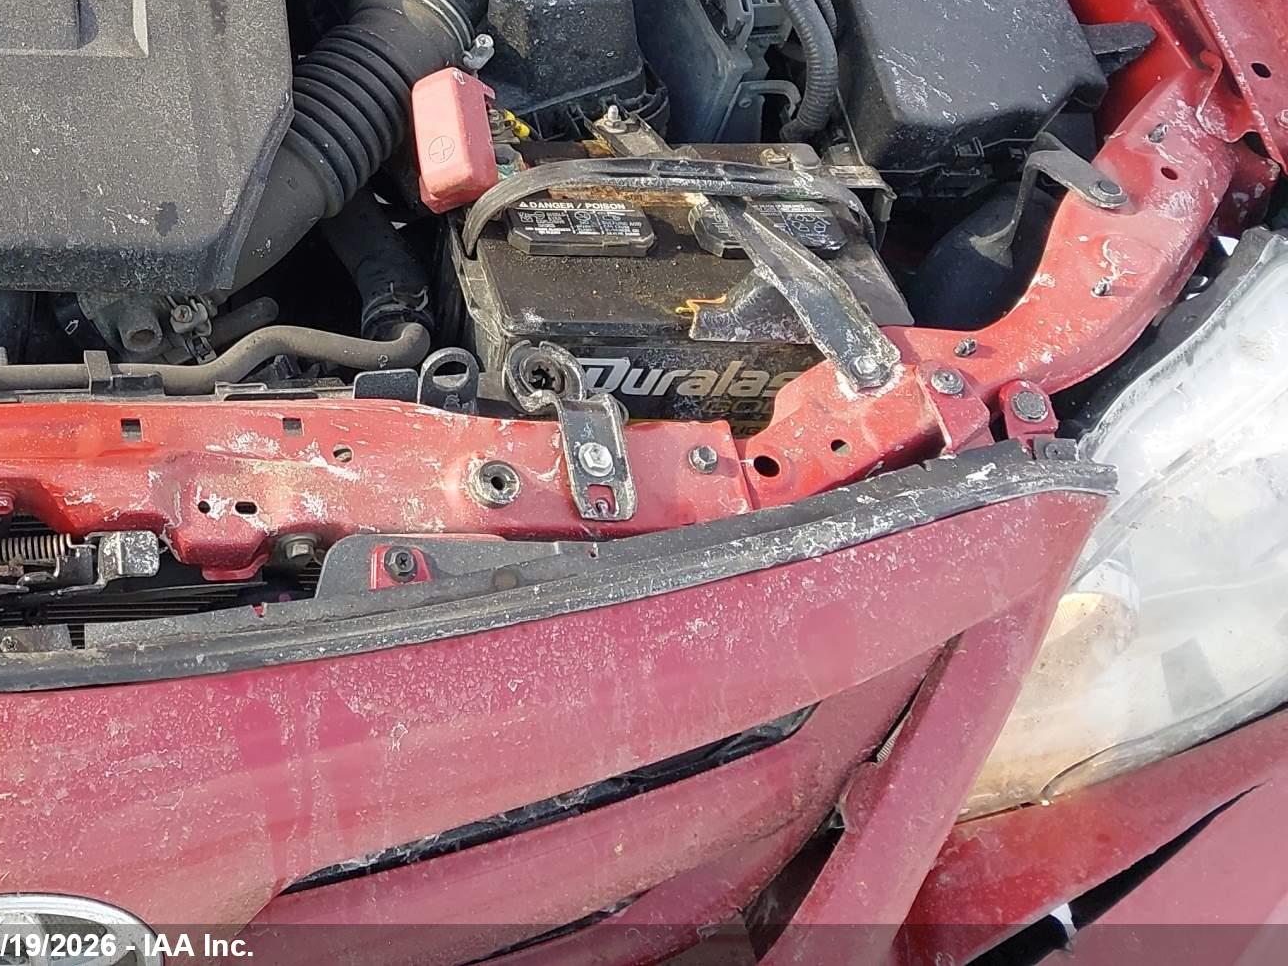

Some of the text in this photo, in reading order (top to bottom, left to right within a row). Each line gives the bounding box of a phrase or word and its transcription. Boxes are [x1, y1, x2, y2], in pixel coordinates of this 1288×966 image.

[529, 201, 575, 209] DANGER
[585, 202, 626, 210] POISON
[579, 356, 806, 397] Duralas
[702, 399, 775, 415] GOL
